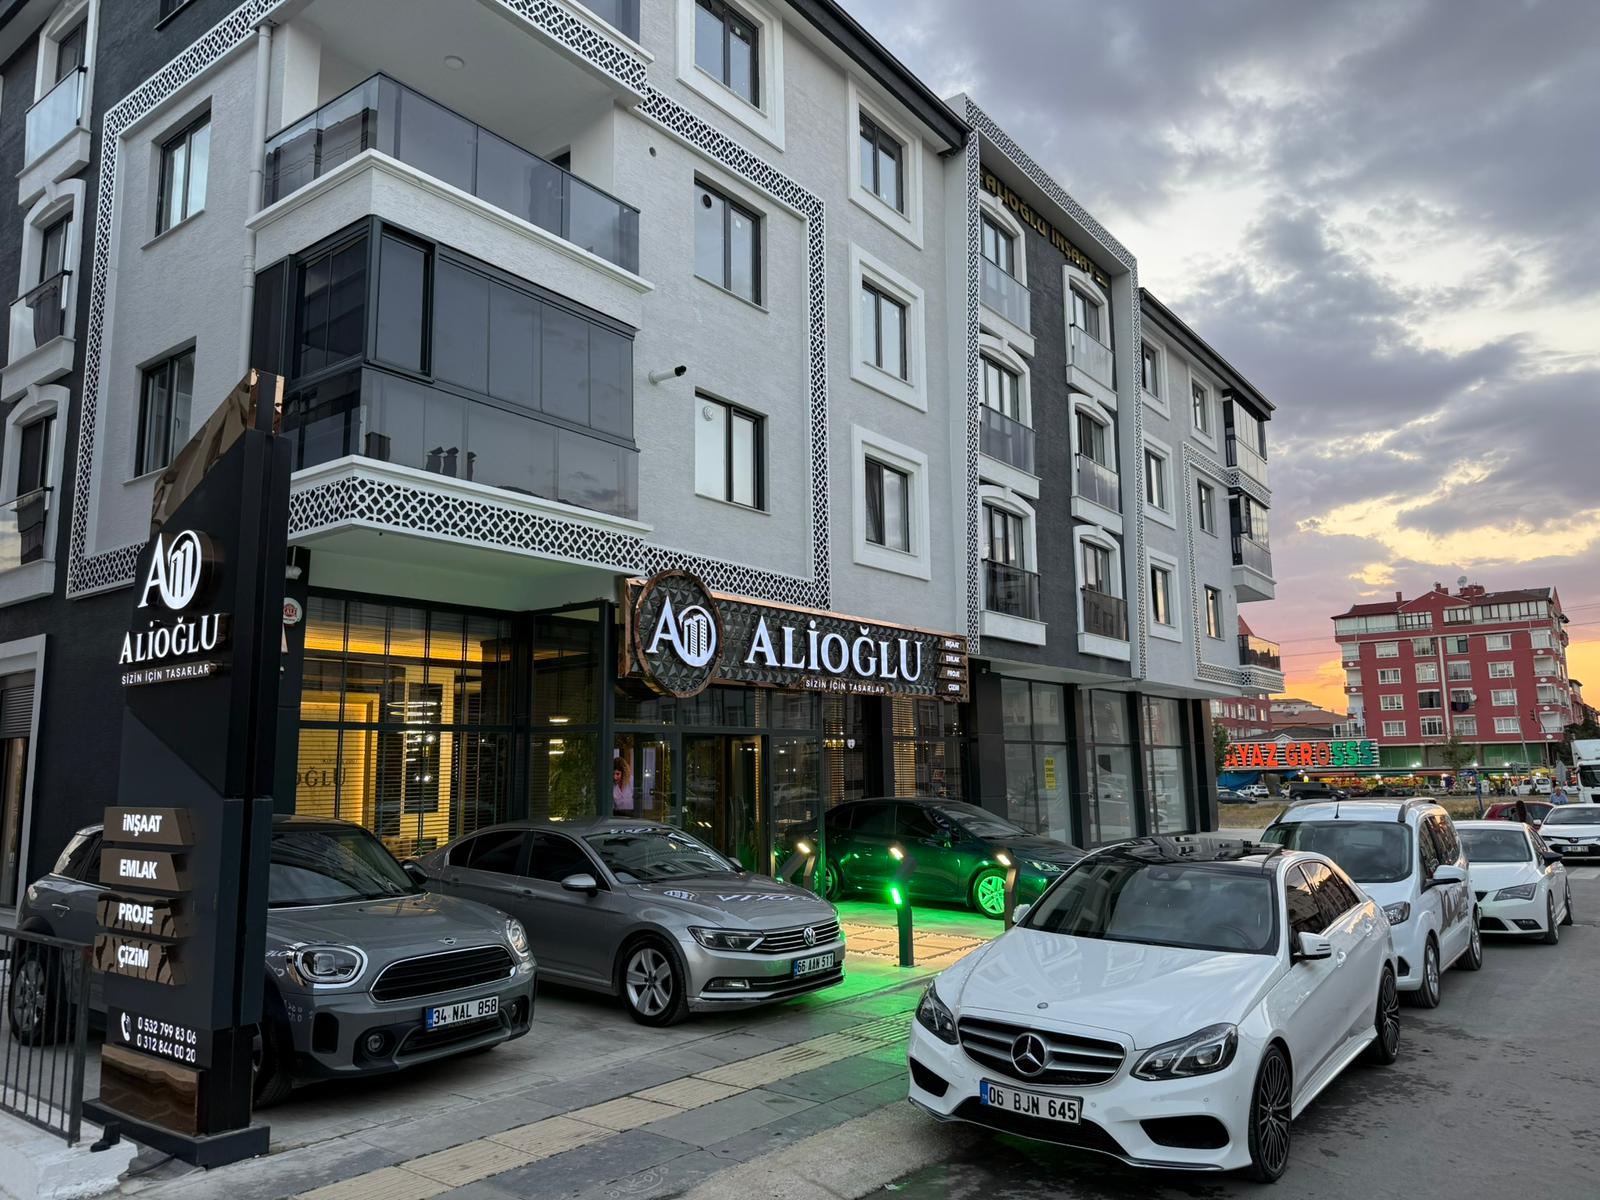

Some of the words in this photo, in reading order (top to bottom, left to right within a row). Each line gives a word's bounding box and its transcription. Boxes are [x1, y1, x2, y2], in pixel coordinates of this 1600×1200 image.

[119, 613, 221, 664] ALİOĞLU
[744, 615, 923, 682] ALİOĞLU
[121, 672, 142, 685] SİZİN
[145, 665, 162, 683] İÇİN
[165, 663, 209, 678] TASARLAR
[849, 683, 885, 693] TASARLAR
[1224, 742, 1278, 768] AYAZ
[1285, 741, 1373, 768] GROSSS
[122, 814, 162, 836] İNŞAAT
[119, 858, 157, 880] EMLAK
[118, 902, 154, 924] PROJE
[117, 945, 149, 967] ÇİZİM
[433, 1008, 447, 1025] 34
[452, 1003, 472, 1021] NAL
[478, 999, 497, 1015] 858
[137, 1016, 143, 1030] 0
[144, 1018, 158, 1034] 532
[160, 1022, 174, 1038] 799
[175, 1027, 185, 1042] 83
[186, 1029, 197, 1045] 06
[136, 1033, 142, 1047] 0
[143, 1035, 158, 1052] 312
[159, 1040, 173, 1055] 844
[174, 1044, 184, 1060] 00
[185, 1047, 197, 1063] 20
[988, 1086, 1004, 1106] 06
[1013, 1092, 1040, 1116] BJN
[1048, 1099, 1077, 1121] 645
